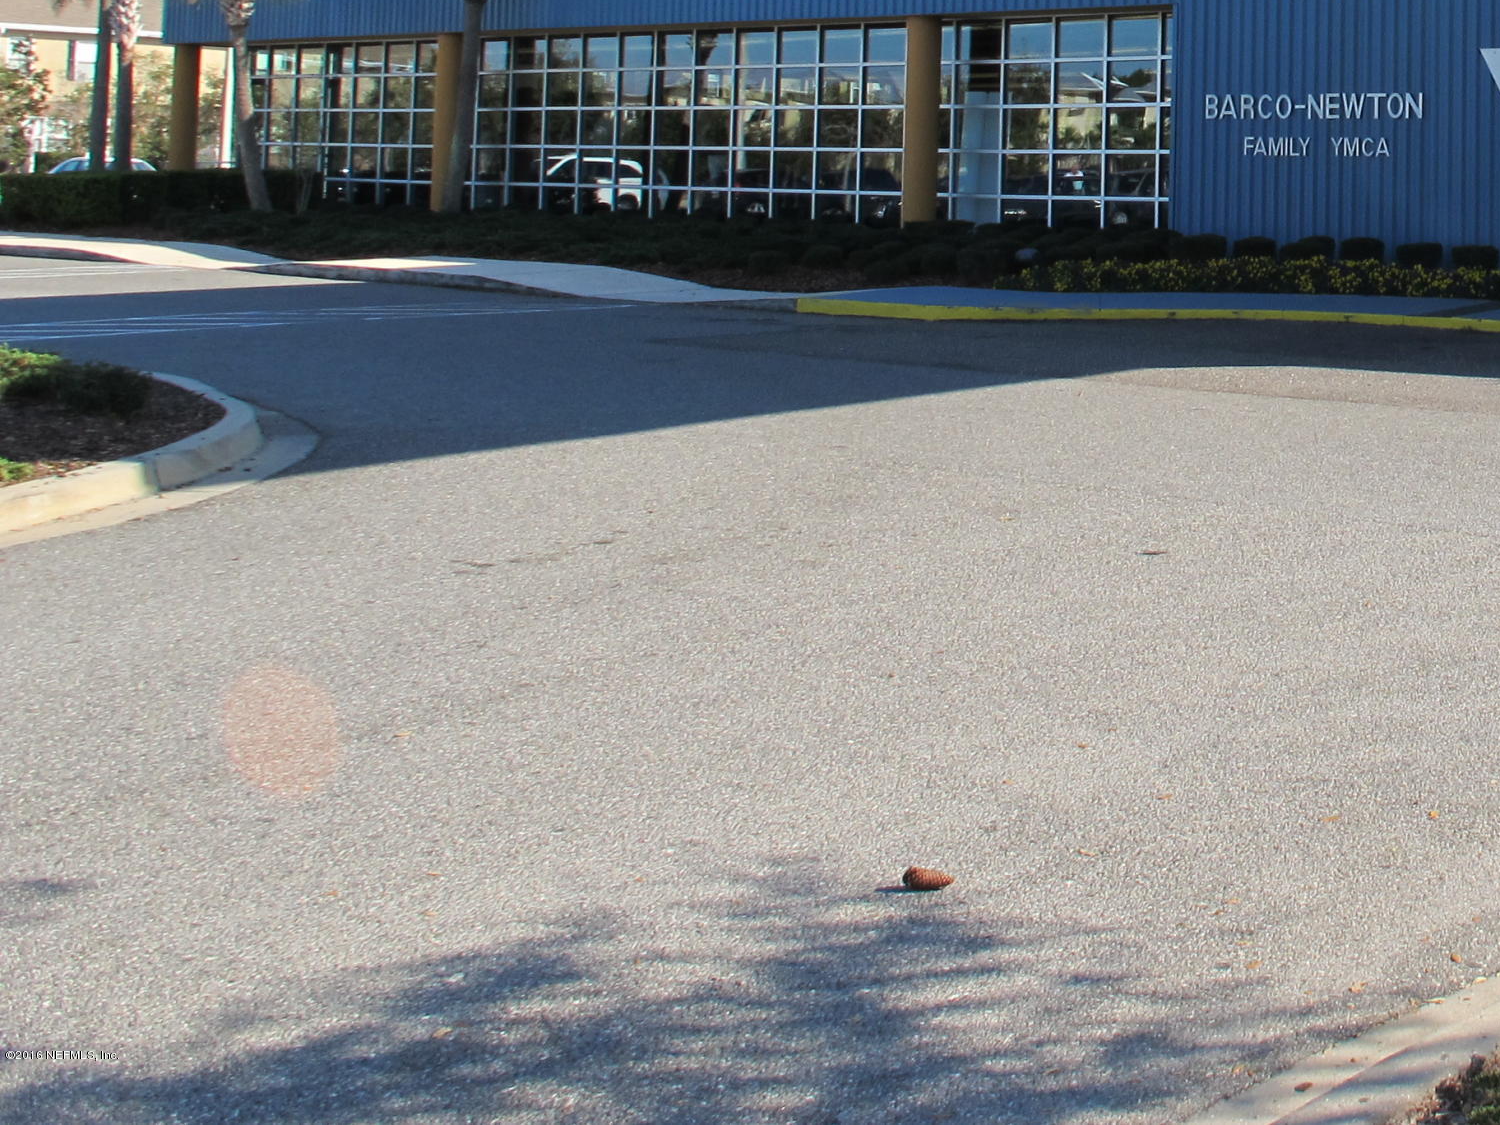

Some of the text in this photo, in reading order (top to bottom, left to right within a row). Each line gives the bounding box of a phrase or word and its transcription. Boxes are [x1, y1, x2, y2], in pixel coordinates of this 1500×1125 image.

[1204, 92, 1424, 120] BARCO-NEWTON
[1243, 136, 1390, 157] FAMILY YMCA
